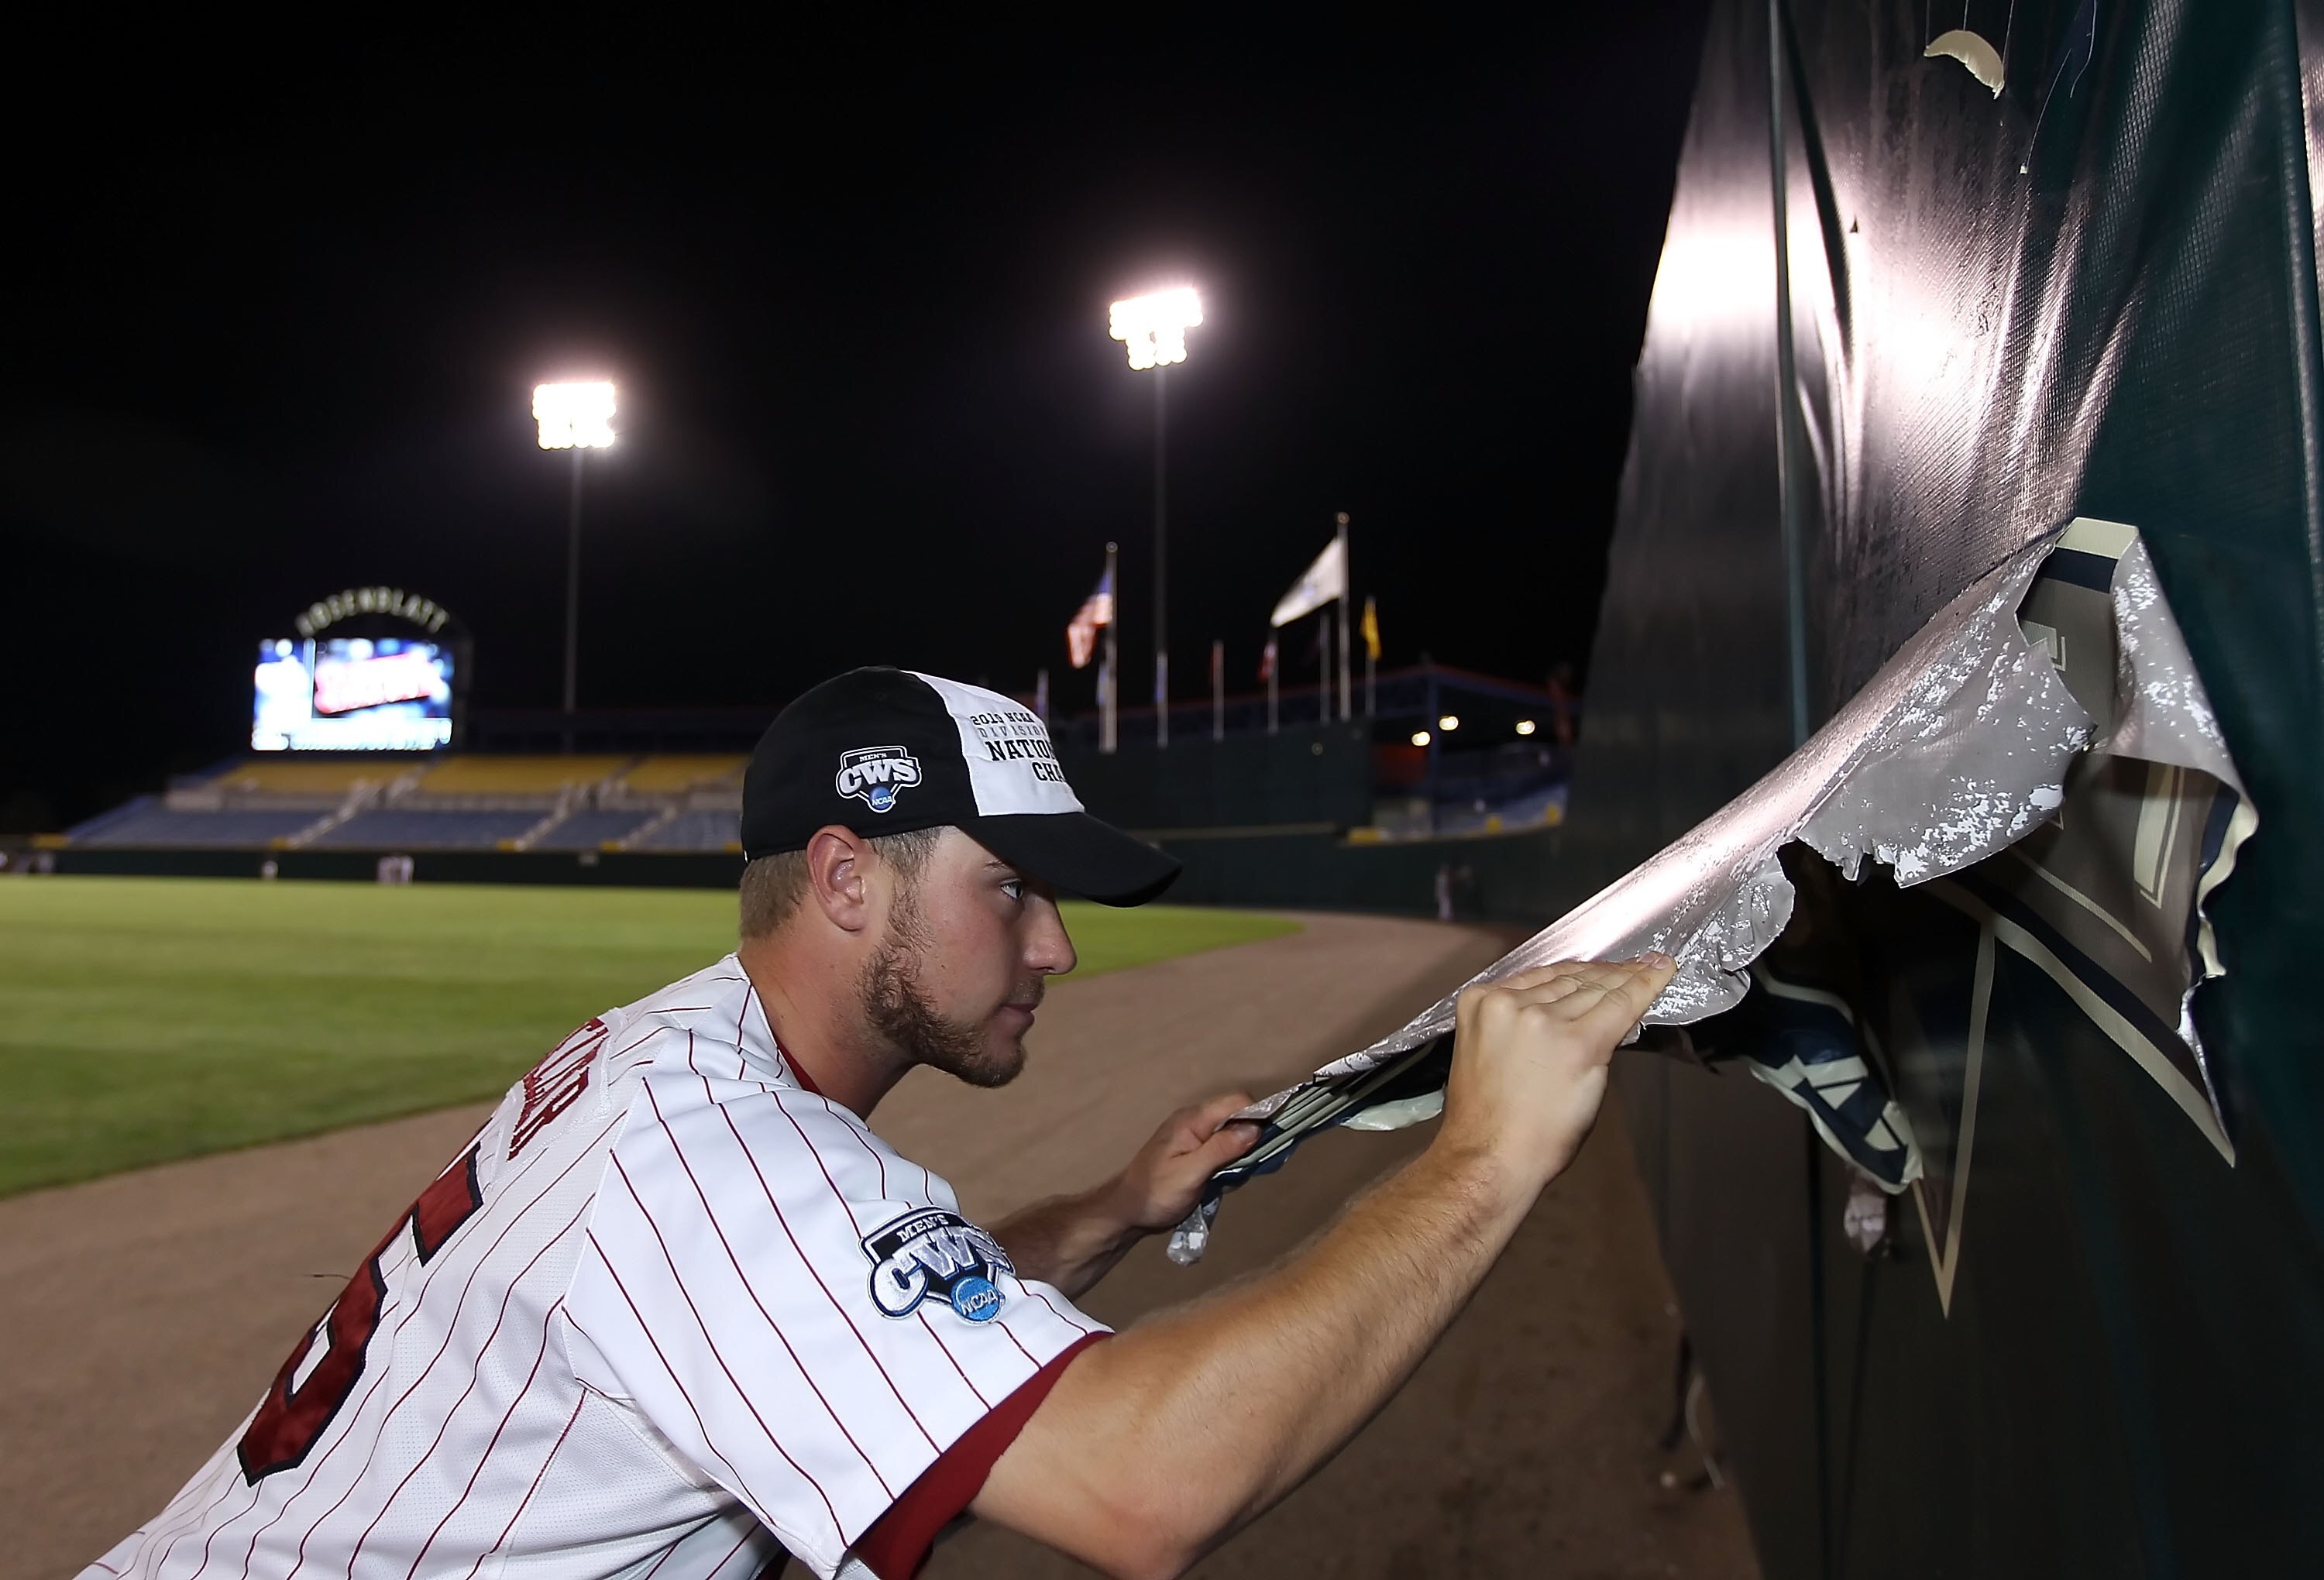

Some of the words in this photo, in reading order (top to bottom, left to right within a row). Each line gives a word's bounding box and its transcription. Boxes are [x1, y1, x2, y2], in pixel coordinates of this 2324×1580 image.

[970, 713, 1005, 726] 2010
[1005, 711, 1035, 723] NCAA
[858, 752, 888, 763] MEN'S
[838, 757, 918, 795] CWS
[871, 795, 894, 806] NCAA
[896, 1214, 950, 1243] MEN'S
[871, 1224, 1012, 1317] CWS
[958, 1289, 999, 1316] NCAA
